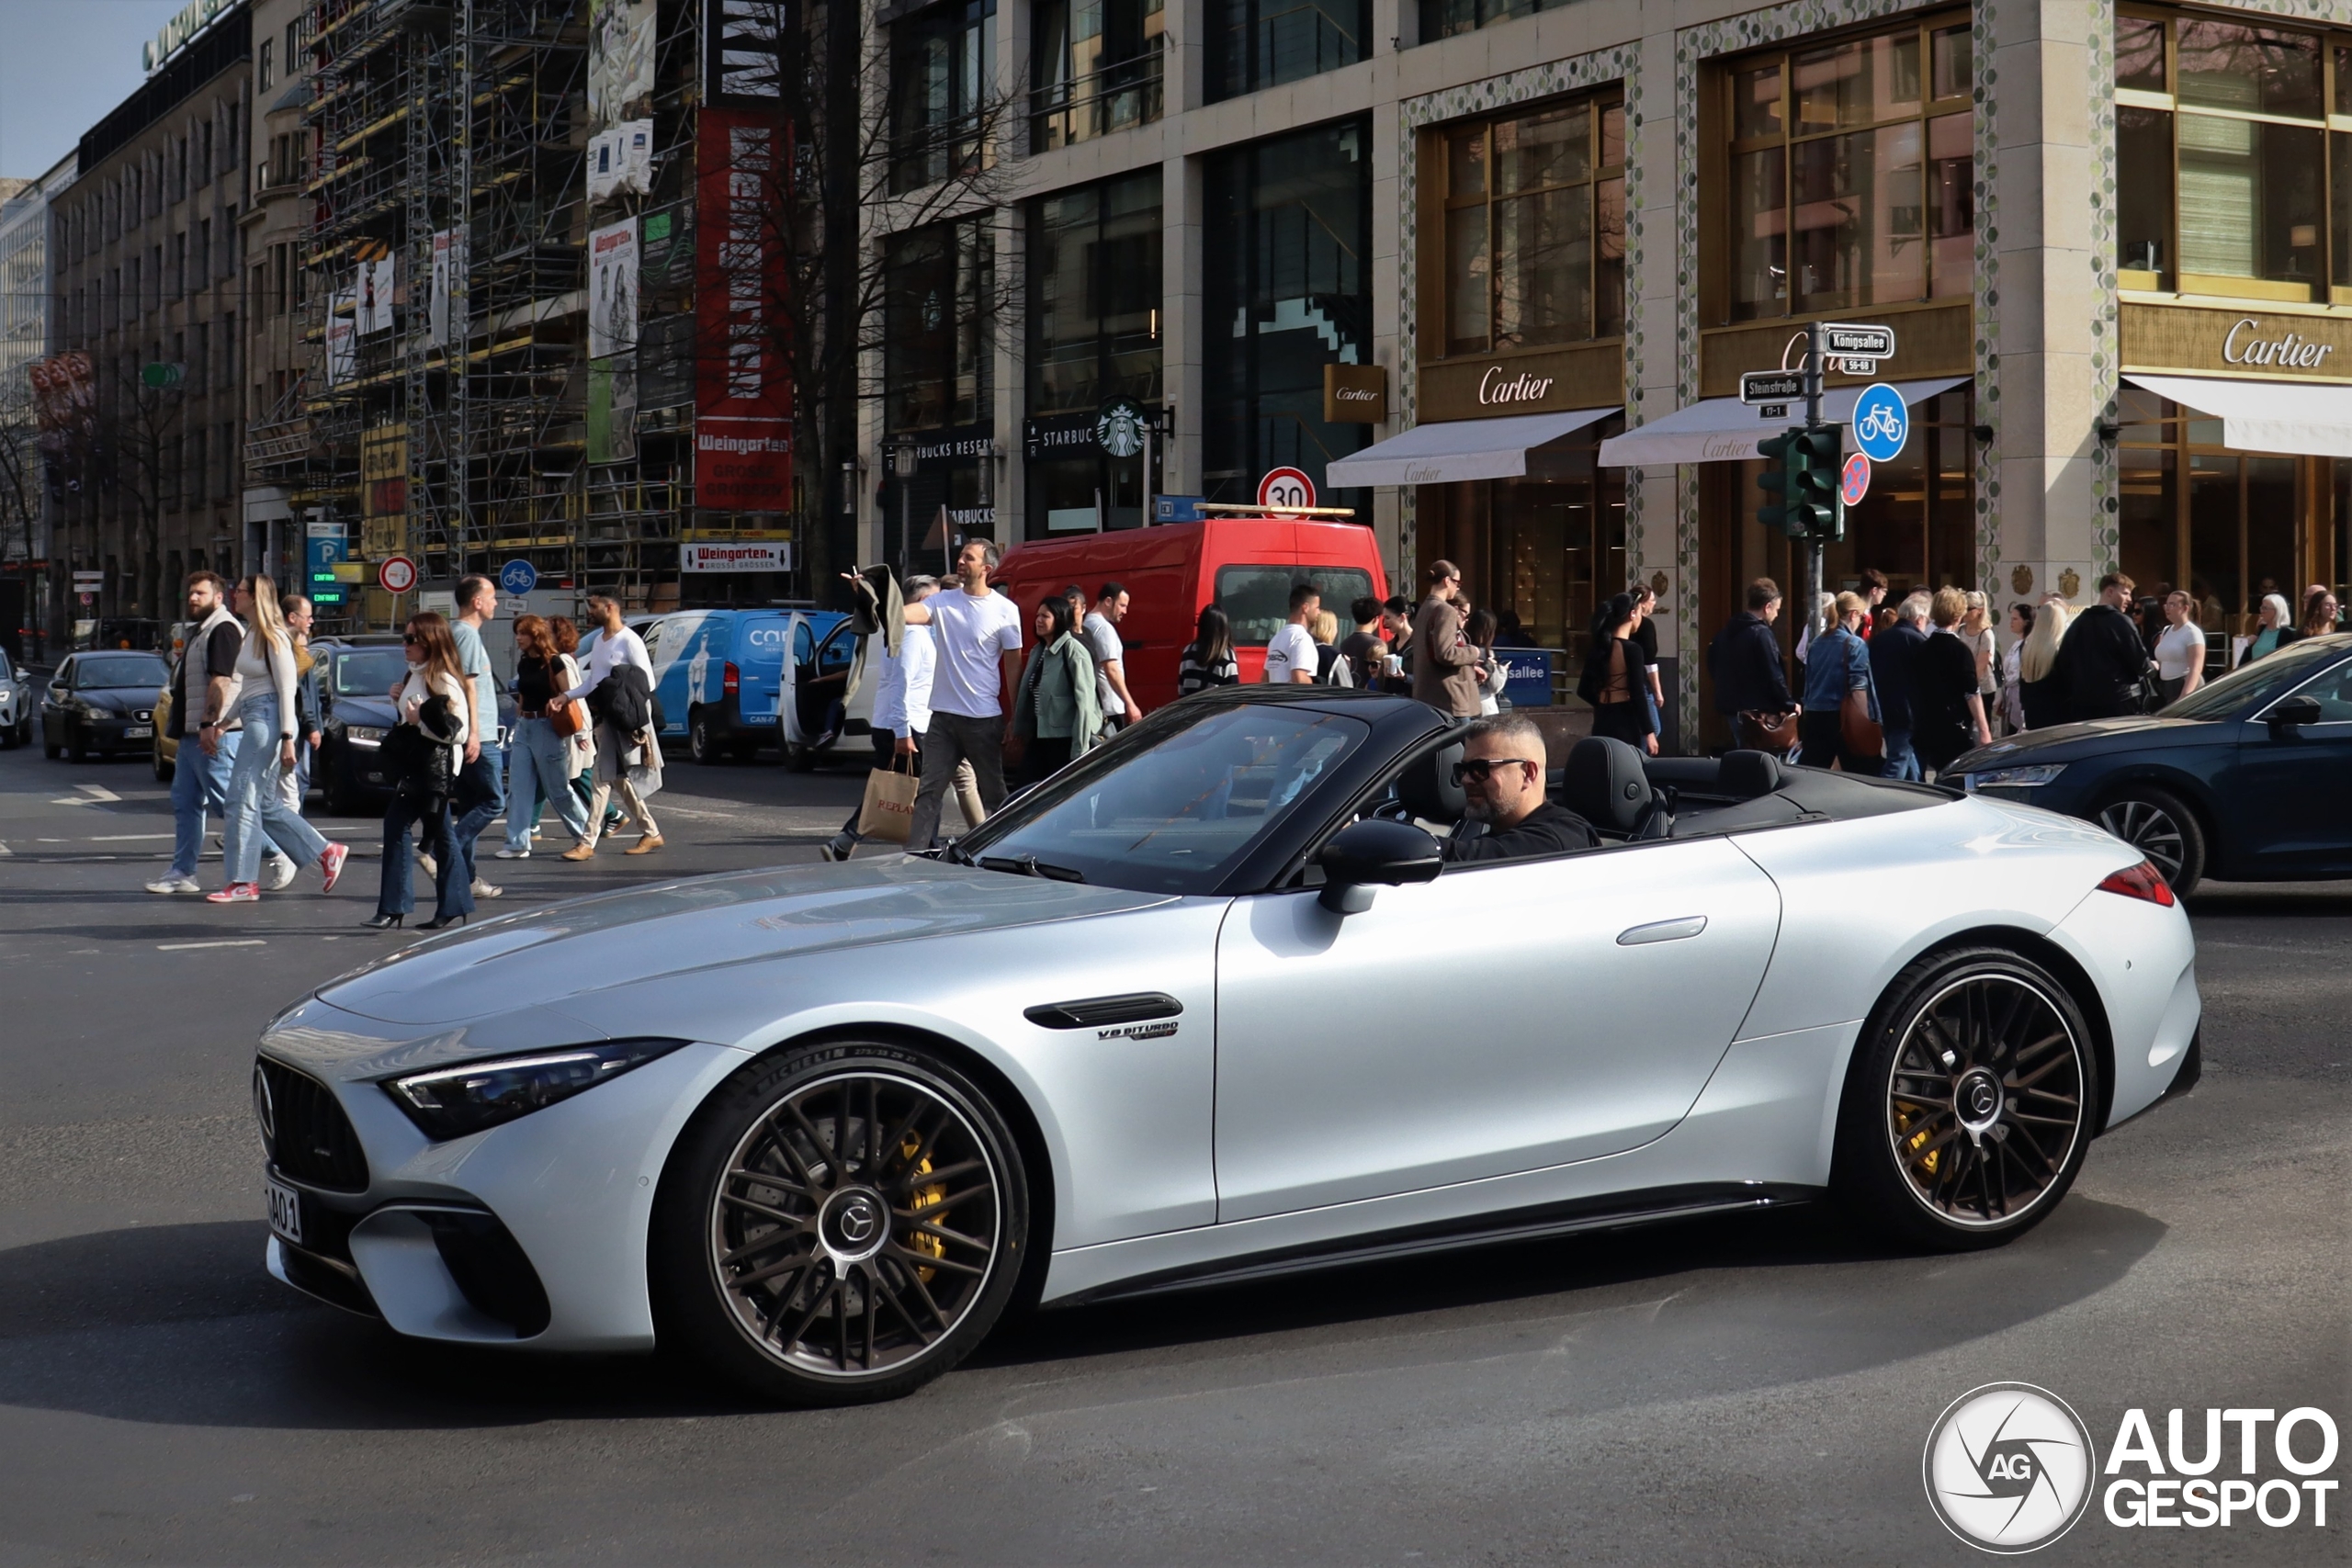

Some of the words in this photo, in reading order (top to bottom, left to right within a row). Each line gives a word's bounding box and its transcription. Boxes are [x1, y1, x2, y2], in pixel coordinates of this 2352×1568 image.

[1833, 333, 1884, 350] Königsallee
[2224, 319, 2333, 367] Cartier
[1336, 387, 1378, 401] Cartier
[1479, 366, 1553, 405] Cartier
[1748, 379, 1797, 395] Steinstraße
[1766, 406, 1781, 416] 17-1
[698, 434, 788, 456] Weingarten
[1043, 427, 1093, 447] STARBUC
[1702, 434, 1751, 459] Cartier
[916, 443, 952, 459] RBUCKS
[956, 438, 995, 456] RESERV
[1404, 461, 1442, 483] Cartier
[1272, 486, 1303, 507] 30
[948, 508, 995, 525] ARBUCKS
[698, 547, 768, 562] Weingarten
[1509, 666, 1544, 679] sallee
[1098, 1029, 1121, 1038] V8
[1124, 1021, 1179, 1035] BITURBO
[755, 1047, 845, 1096] MICHELIN
